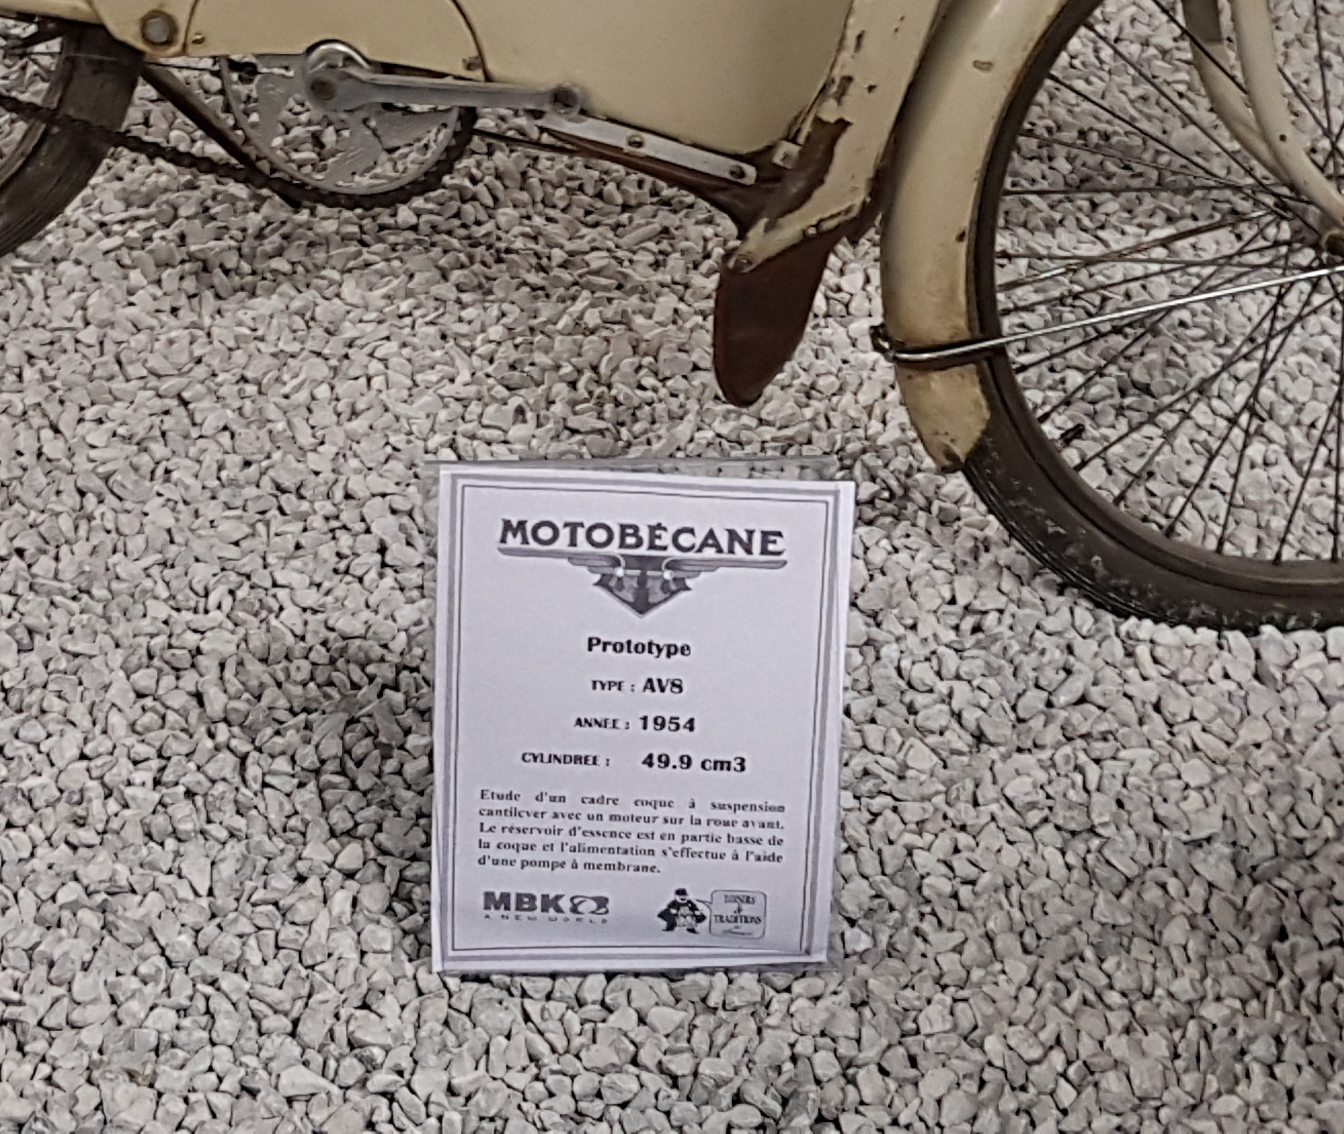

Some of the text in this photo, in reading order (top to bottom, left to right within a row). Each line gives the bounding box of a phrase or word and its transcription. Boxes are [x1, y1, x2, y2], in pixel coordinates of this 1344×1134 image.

[499, 517, 787, 556] MOTOBÉCANE
[587, 636, 692, 659] Prototype
[591, 679, 624, 692] TYPE
[639, 715, 696, 733] 1954
[641, 752, 693, 771] 49.9
[700, 756, 747, 773] cm3
[534, 791, 567, 804] d'un
[581, 794, 620, 806] cadre
[633, 798, 675, 811] coque
[710, 801, 786, 814] suspension
[478, 807, 785, 830] cantilever avec un moteur sur la roue avant.
[479, 822, 784, 847] Le réservoir d'essence est en partie basse de
[478, 838, 491, 849] la
[496, 840, 537, 854] coque
[542, 842, 555, 852] et
[560, 841, 655, 856] l'alimentation
[477, 854, 517, 866] d'une
[520, 858, 567, 871] pompe
[583, 861, 661, 874] membrane.
[483, 891, 565, 914] MBK
